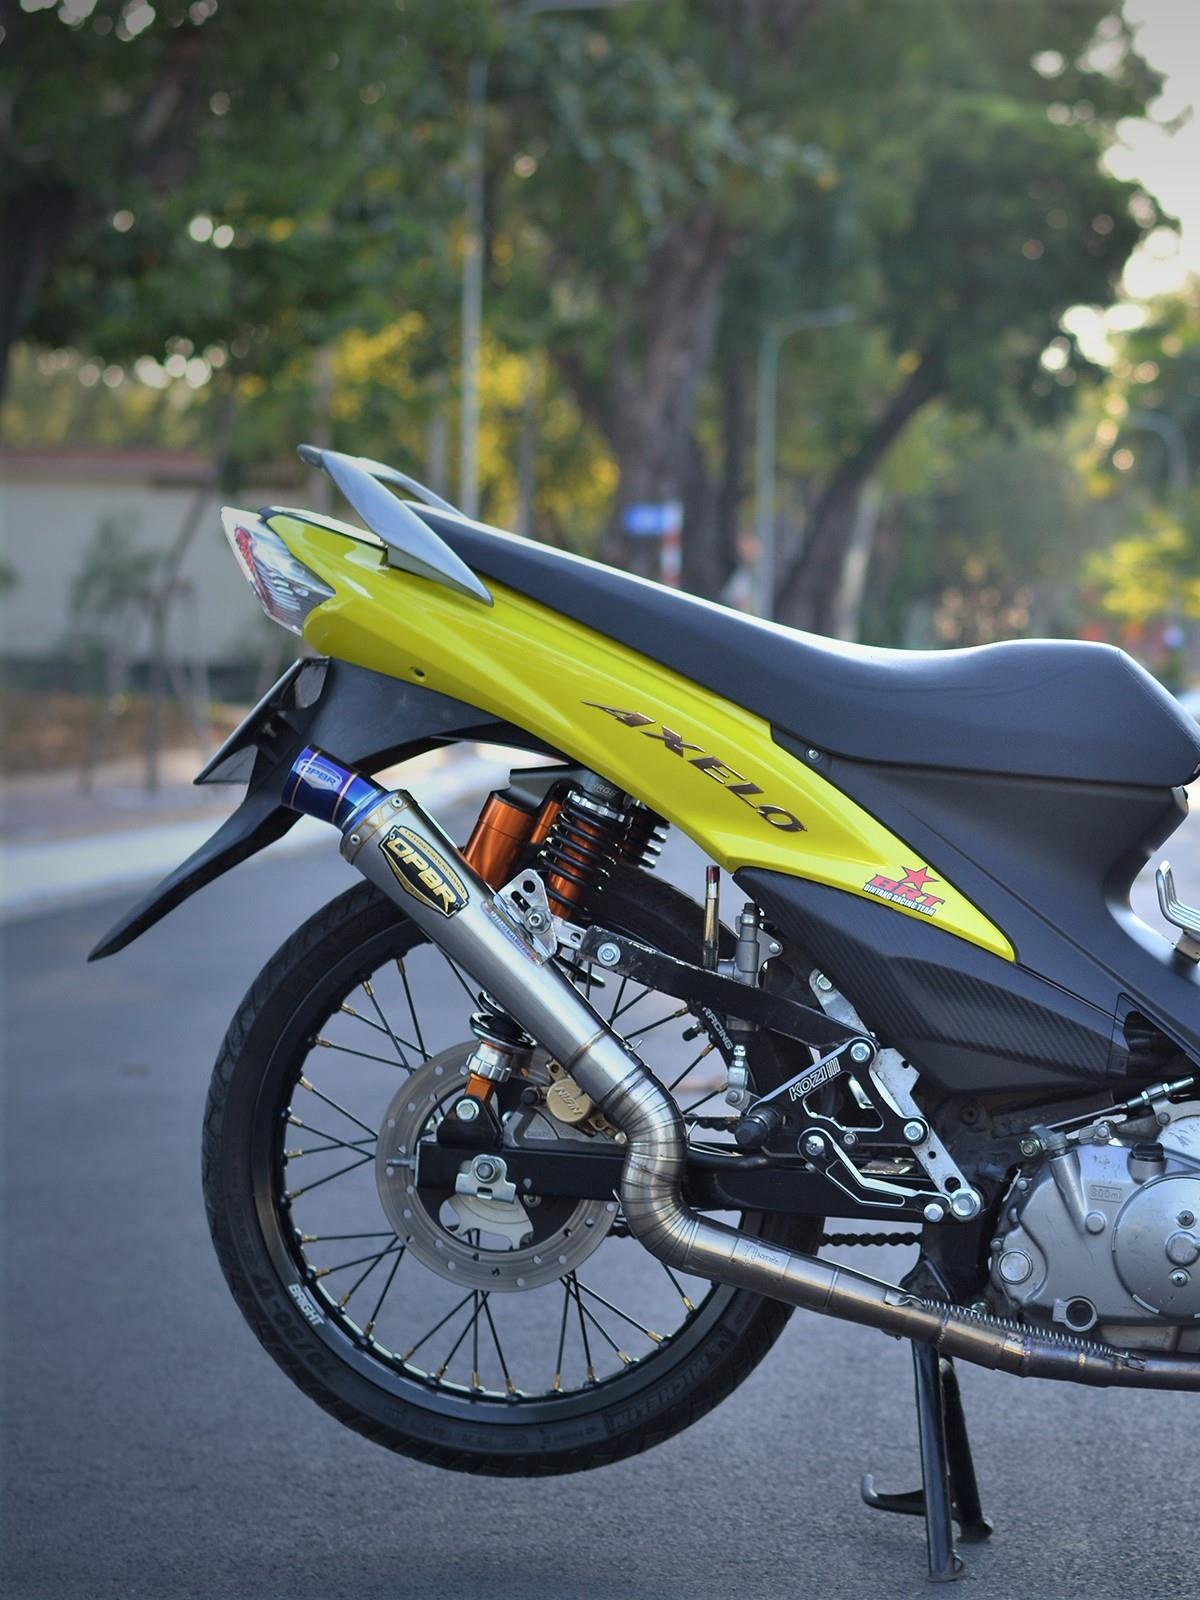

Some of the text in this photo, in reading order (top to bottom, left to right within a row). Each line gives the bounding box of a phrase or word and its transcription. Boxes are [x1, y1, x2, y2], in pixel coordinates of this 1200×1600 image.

[580, 701, 808, 832] AXELO
[387, 837, 457, 913] OPBR
[862, 883, 937, 917] BINTANG RACING TEAM
[868, 874, 946, 908] BRT
